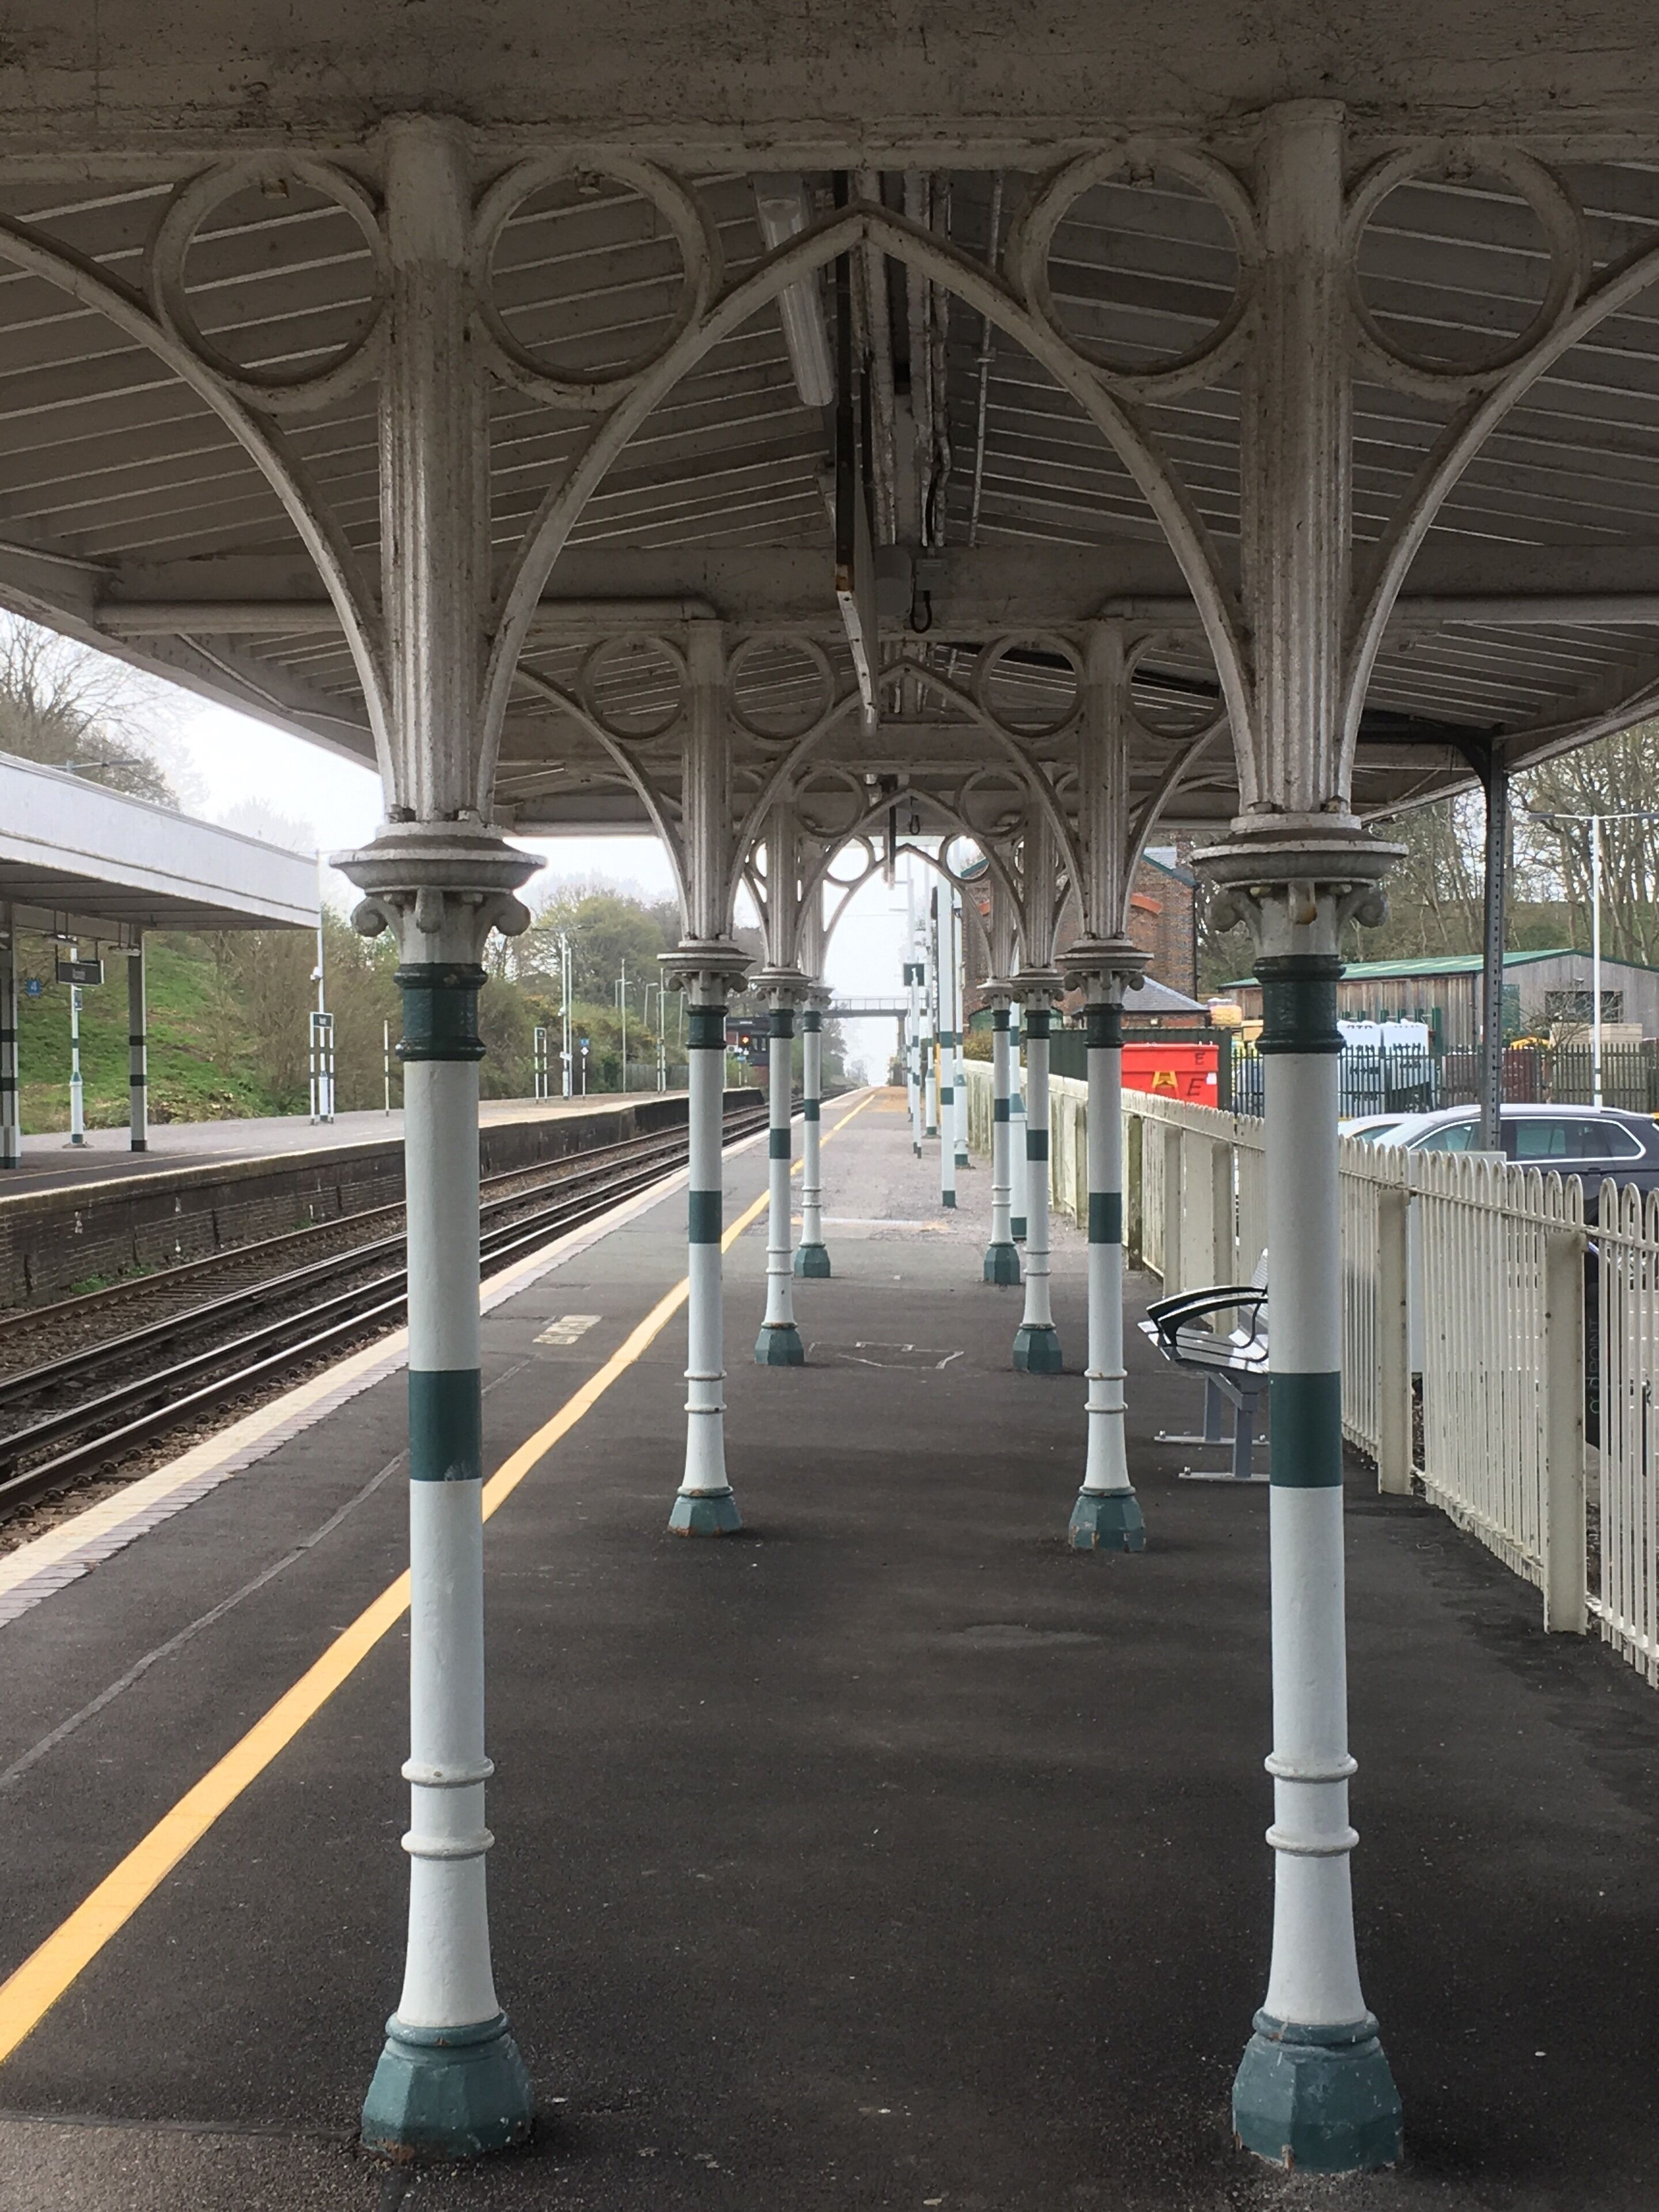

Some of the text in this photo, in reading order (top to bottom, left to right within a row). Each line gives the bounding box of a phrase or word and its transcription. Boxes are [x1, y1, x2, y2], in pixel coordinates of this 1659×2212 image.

[31, 981, 37, 991] 4
[1195, 1051, 1206, 1065] E
[1187, 1078, 1205, 1096] E
